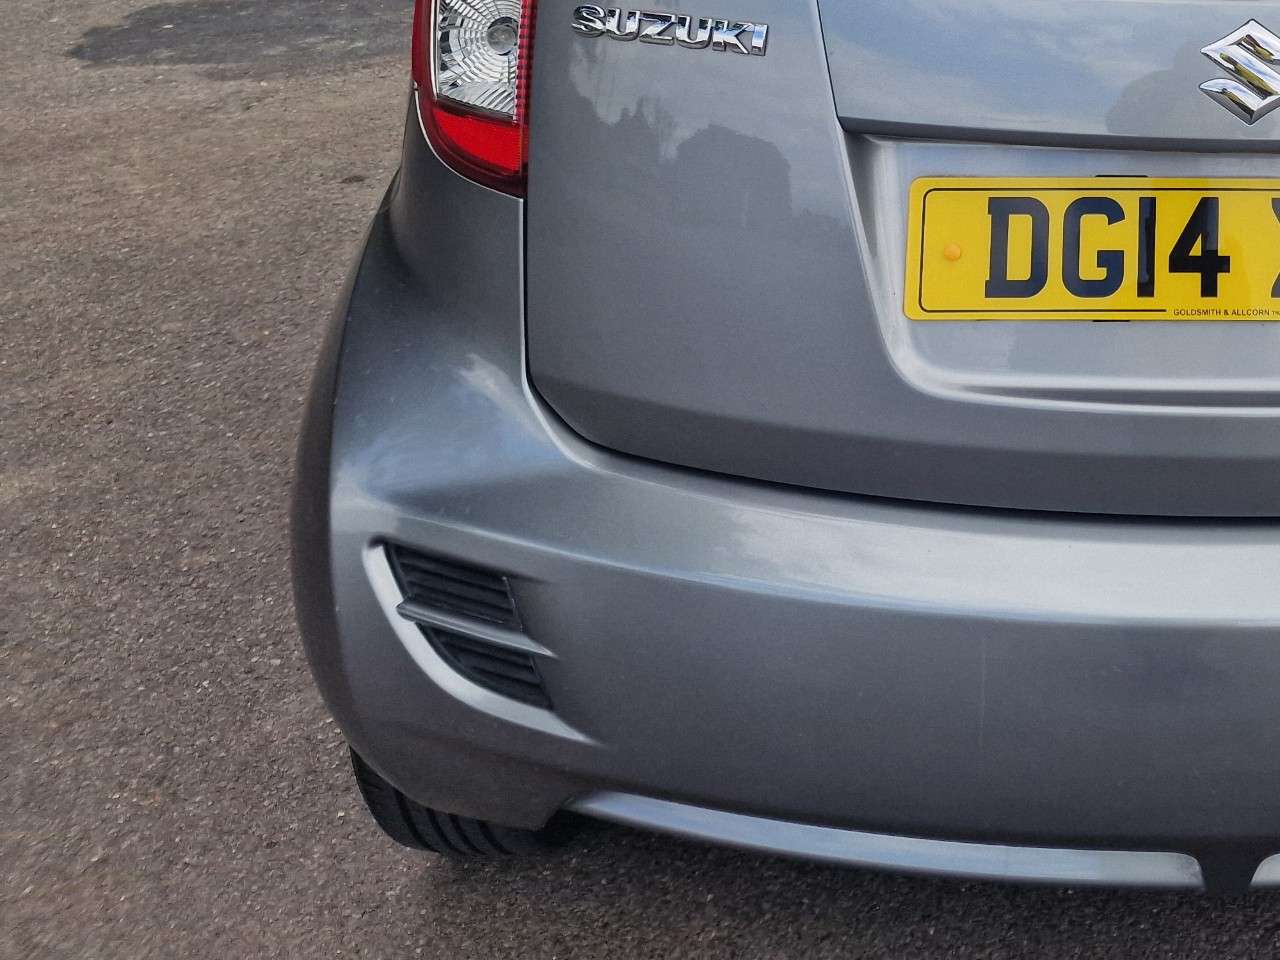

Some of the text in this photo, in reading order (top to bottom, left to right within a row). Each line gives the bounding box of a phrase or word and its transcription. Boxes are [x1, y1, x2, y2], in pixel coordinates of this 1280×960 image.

[571, 4, 769, 56] SUZUKI
[985, 196, 1230, 300] DG14
[1173, 308, 1221, 316] GOLDSMITH
[1223, 308, 1229, 316] &
[1231, 308, 1270, 317] ALLCORN
